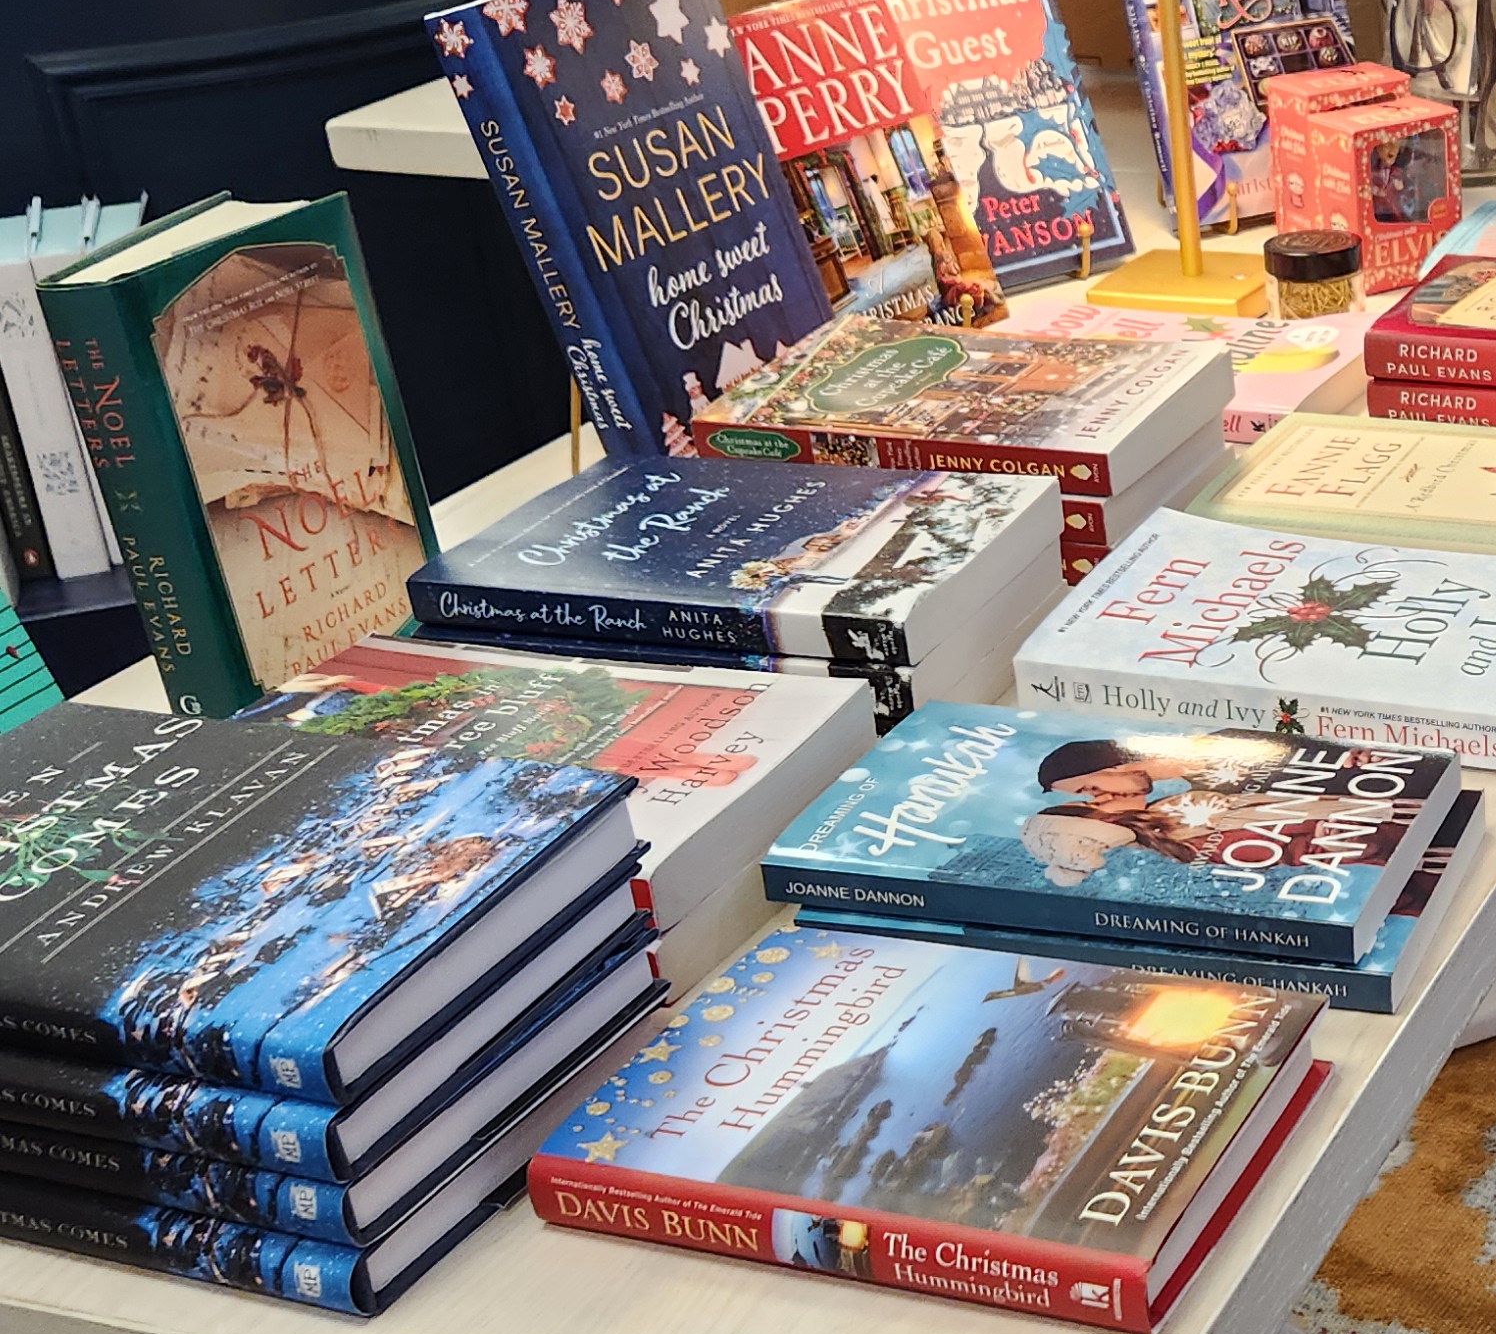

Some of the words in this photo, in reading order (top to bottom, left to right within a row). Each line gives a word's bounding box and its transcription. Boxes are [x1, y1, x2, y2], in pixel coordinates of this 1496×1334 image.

[748, 5, 899, 95] ANNE
[906, 27, 1012, 69] Guest
[756, 58, 915, 151] PERRY
[588, 104, 735, 201] SUSAN
[480, 120, 530, 210] SUSAN
[521, 216, 581, 331] MALLERY
[586, 152, 770, 272] MALLERY
[982, 194, 1040, 222] Peter
[648, 261, 713, 308] home
[714, 220, 770, 278] sweet
[669, 273, 784, 351] Christmas
[85, 338, 106, 371] THE
[819, 347, 900, 398] Christmas
[1387, 361, 1431, 378] PAUL
[1437, 366, 1493, 383] EVANS
[1399, 343, 1478, 363] RICHARD
[56, 339, 111, 470] LETTERS
[566, 344, 609, 431] Christmas
[1075, 399, 1123, 440] JENNY
[1125, 347, 1190, 397] COLGAN
[1399, 391, 1478, 411] RICHARD
[94, 375, 136, 469] NOEL
[712, 430, 757, 447] Christmas
[769, 436, 789, 450] the
[929, 452, 984, 472] JENNY
[989, 458, 1066, 480] COLGAN
[1265, 434, 1362, 498] FANNIE
[1315, 440, 1403, 498] FLAGG
[241, 468, 381, 562] NOEL
[517, 484, 651, 567] Christmas
[649, 471, 682, 497] at
[602, 530, 659, 563] the
[647, 485, 730, 542] Ranch
[687, 536, 751, 580] ANITA
[751, 479, 828, 535] HUGHES
[122, 535, 150, 590] PAUL
[143, 600, 176, 674] EVANS
[149, 556, 193, 657] RICHARD
[302, 580, 388, 644] RICHARD
[346, 596, 409, 650] EVANS
[439, 591, 526, 624] Christmas
[529, 601, 550, 623] at
[554, 600, 585, 627] the
[589, 604, 648, 632] Ranch
[668, 609, 724, 627] ANITA
[1096, 557, 1212, 627] Fern
[1137, 538, 1308, 669] Michaels
[1357, 577, 1492, 666] Holly
[661, 625, 738, 645] HUGHES
[495, 670, 567, 717] bluff
[1101, 683, 1172, 716] Holly
[1177, 700, 1219, 720] and
[1225, 699, 1267, 728] Ivy
[1320, 705, 1330, 714] #1
[1331, 706, 1350, 716] NEW
[1351, 708, 1376, 719] YORK
[1377, 712, 1403, 723] TIMES
[1404, 716, 1461, 729] BESTSELLING
[638, 680, 773, 775] Woodson
[1315, 715, 1376, 742] Fern
[183, 750, 311, 835] KLAVAN
[646, 730, 765, 806] Harvey
[852, 720, 1018, 858] Hanukah
[798, 791, 866, 852] DREAMING
[859, 776, 881, 794] OF
[1211, 747, 1350, 894] JOANNE
[1276, 750, 1424, 906] DANNON
[785, 880, 851, 902] JOANNE
[853, 887, 925, 909] DANNON
[1093, 910, 1201, 938] DREAMING
[1204, 924, 1230, 939] OF
[1233, 927, 1311, 949] HANKAH
[1241, 974, 1269, 991] OF
[1270, 978, 1349, 999] HANKAH
[22, 1018, 97, 1044] COMES
[650, 1096, 717, 1140] The
[704, 946, 876, 1090] Christmas
[718, 963, 908, 1133] Hummingbird
[21, 1092, 97, 1117] COMES
[1079, 1103, 1197, 1227] DAVIS
[1172, 986, 1279, 1097] BUNN
[49, 1144, 121, 1173] COMES
[550, 1176, 607, 1195] Internationally
[608, 1185, 653, 1202] Bestselling
[653, 1194, 682, 1207] Author
[682, 1200, 692, 1208] of
[693, 1201, 709, 1212] The
[709, 1204, 743, 1218] Emerald
[744, 1210, 763, 1222] Tide
[554, 1190, 651, 1231] DAVIS
[661, 1209, 760, 1252] BUNN
[57, 1223, 129, 1249] COMES
[882, 1231, 928, 1263] The
[934, 1242, 1060, 1288] Christmas
[893, 1263, 1051, 1308] Hummingbird
